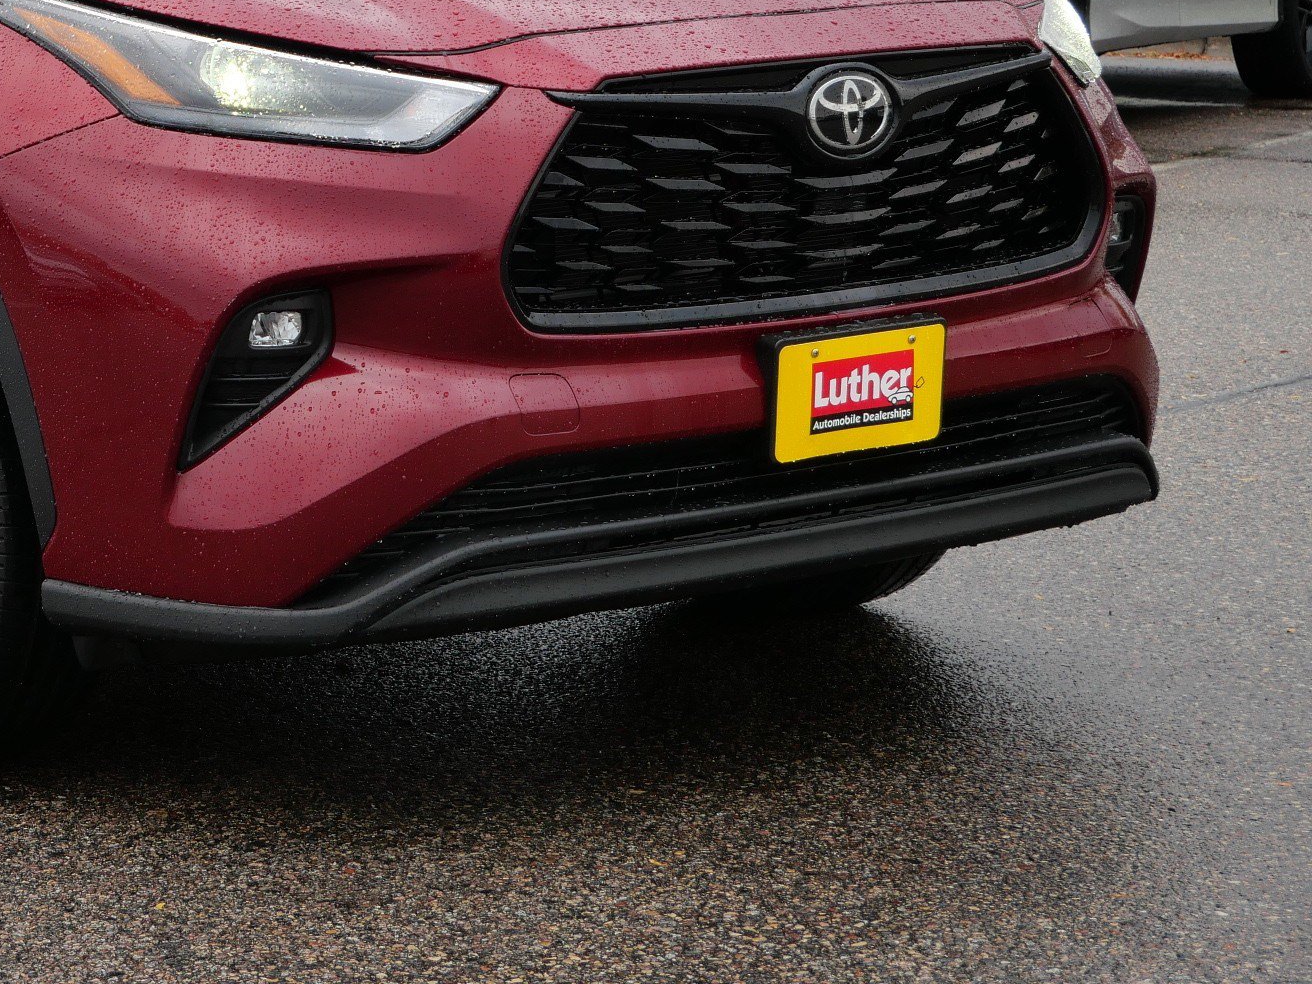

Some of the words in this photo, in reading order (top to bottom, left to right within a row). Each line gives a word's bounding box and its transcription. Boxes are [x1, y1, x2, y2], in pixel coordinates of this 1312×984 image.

[814, 364, 912, 408] Luther
[813, 414, 861, 431] Automobile
[862, 407, 911, 422] Dealerships
